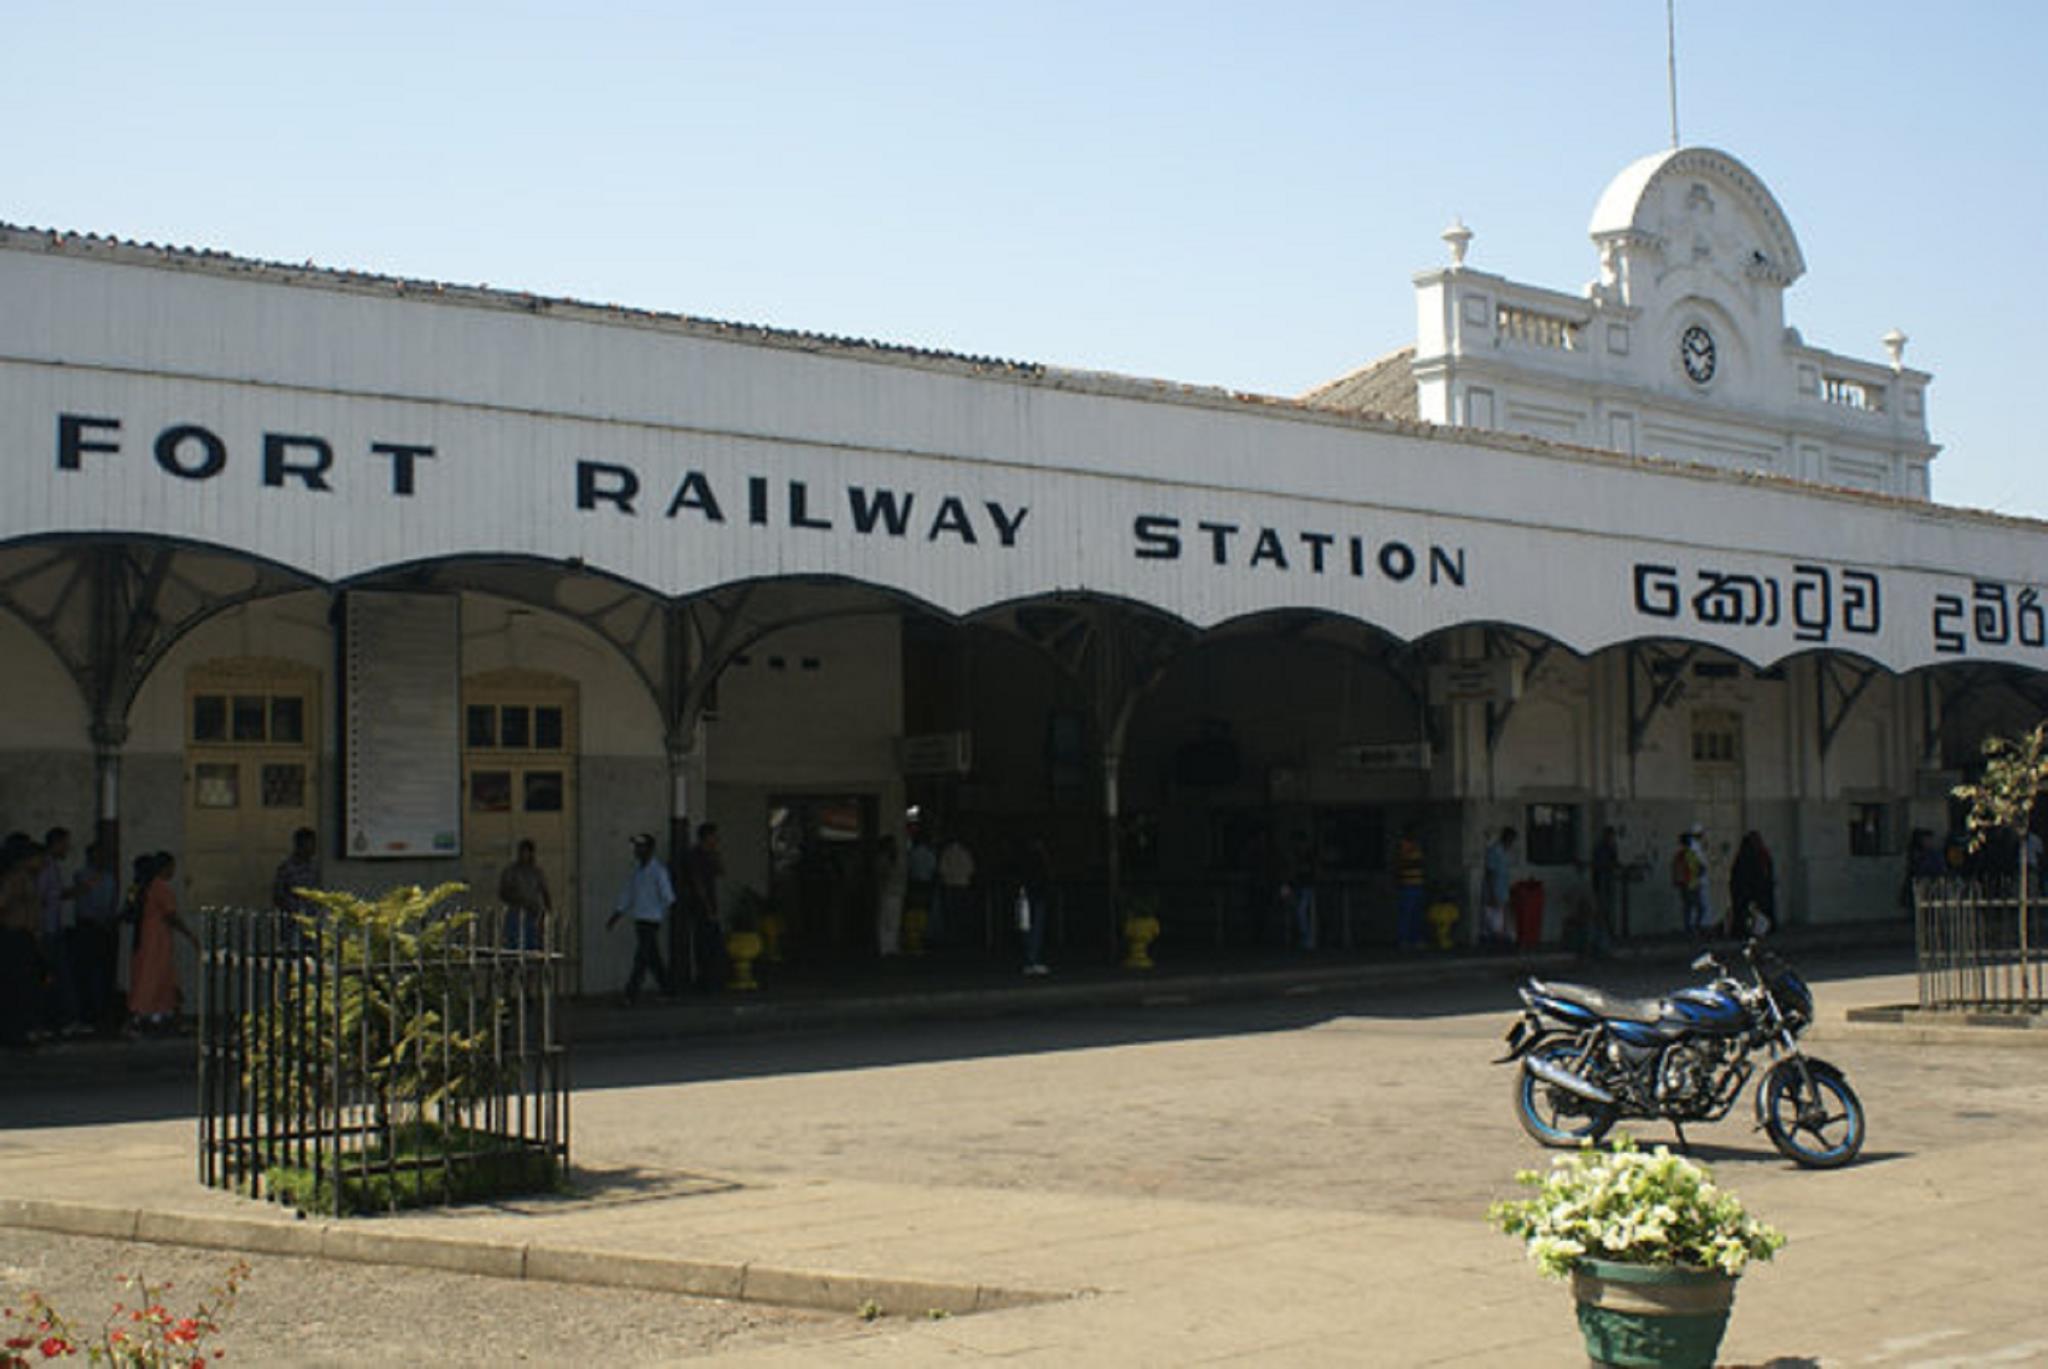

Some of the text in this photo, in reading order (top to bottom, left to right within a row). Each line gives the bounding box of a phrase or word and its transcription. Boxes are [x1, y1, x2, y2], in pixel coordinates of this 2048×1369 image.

[56, 412, 1467, 589] FORT RAILWAY STATION
[1633, 562, 1882, 644] කොටුව
